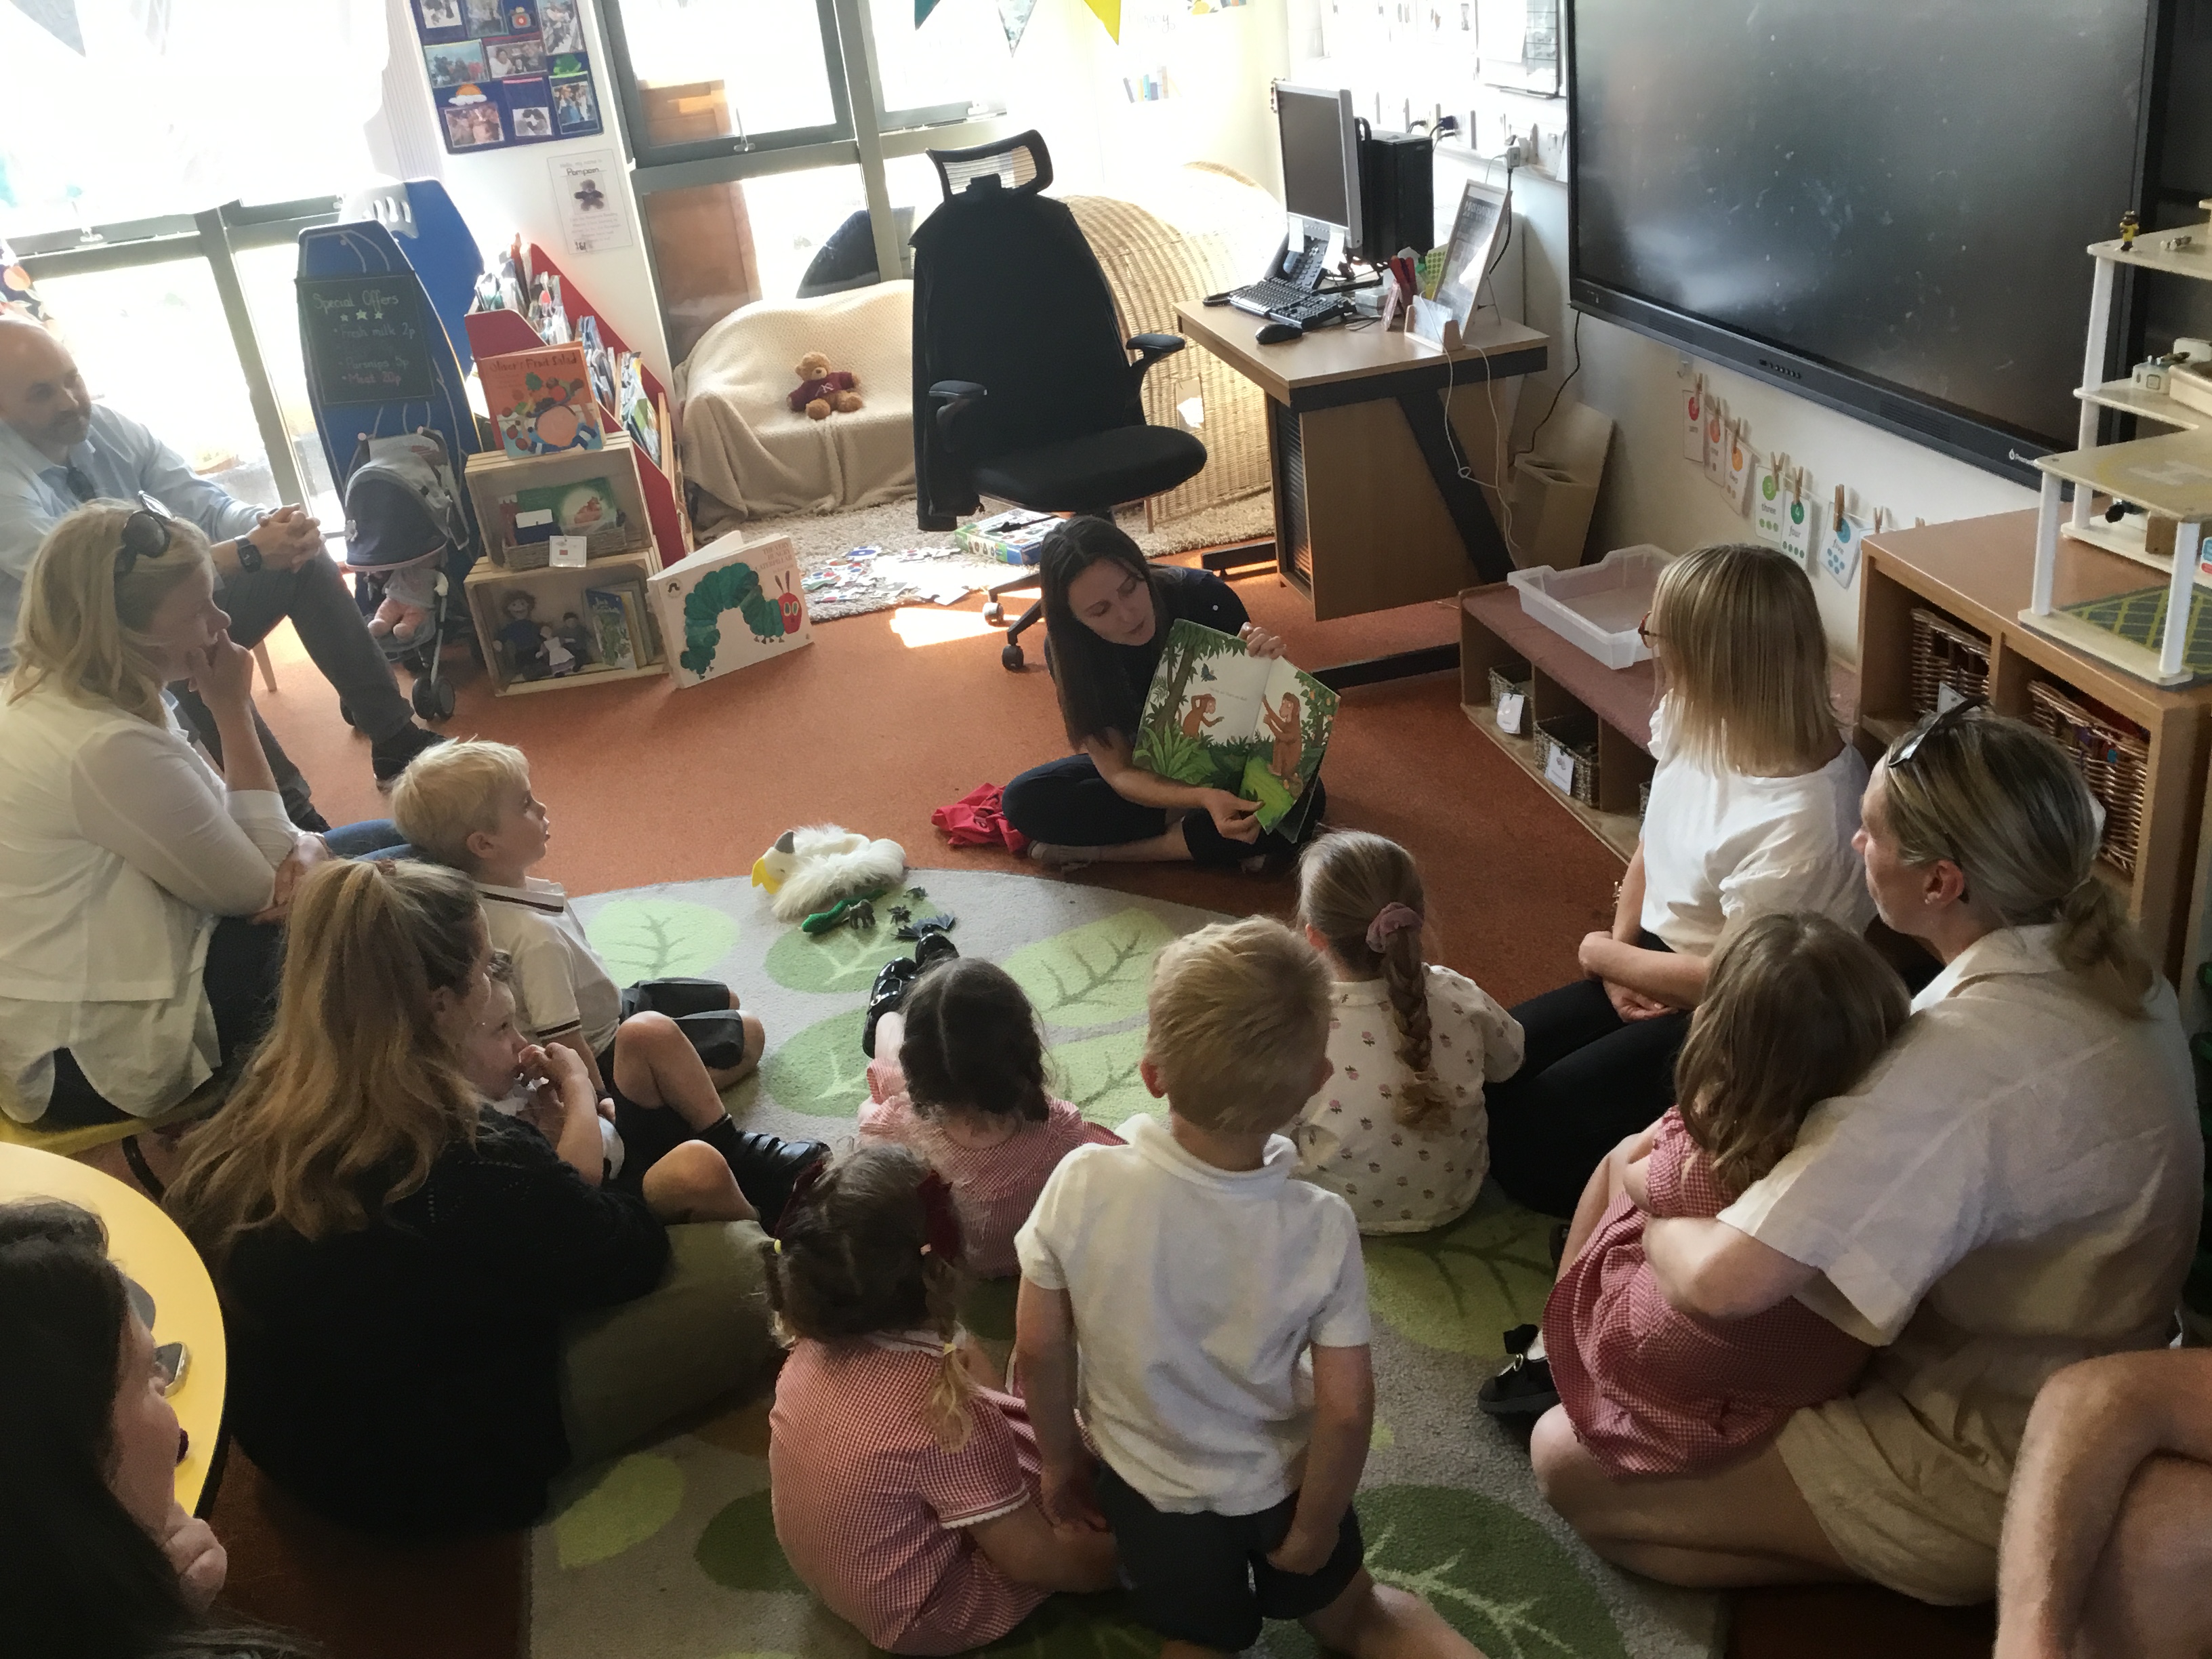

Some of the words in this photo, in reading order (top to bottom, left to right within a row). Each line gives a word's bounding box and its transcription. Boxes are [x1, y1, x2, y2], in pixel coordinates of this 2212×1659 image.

[312, 291, 355, 314] Special
[362, 289, 398, 312] Offers
[340, 324, 368, 337] Fresh
[373, 323, 396, 336] milk
[402, 322, 415, 340] 2p
[346, 356, 389, 371] Parsnips
[395, 356, 409, 369] 5p
[526, 358, 549, 369] Fruit
[552, 352, 577, 365] Salad
[1767, 482, 1771, 494] 3
[1761, 503, 1776, 515] three
[1795, 506, 1800, 518] 4
[1788, 525, 1801, 538] four
[762, 547, 773, 555] THE
[774, 542, 789, 550] VERY
[1832, 539, 1844, 555] five
[768, 549, 790, 560] HUNGRY
